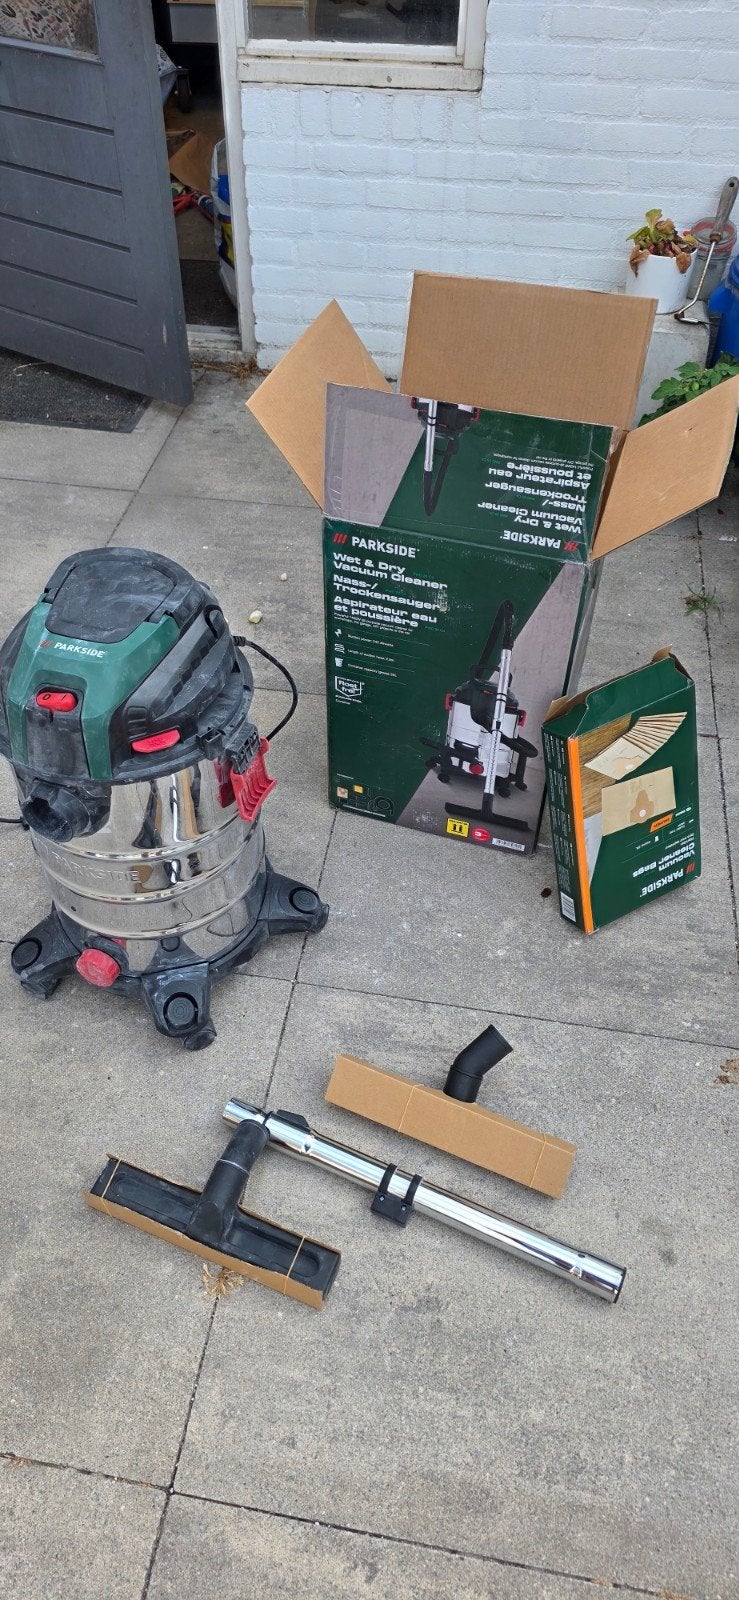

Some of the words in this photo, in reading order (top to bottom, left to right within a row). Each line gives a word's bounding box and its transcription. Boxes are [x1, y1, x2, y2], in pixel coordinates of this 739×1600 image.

[489, 467, 512, 478] eau
[507, 462, 574, 478] poussière
[516, 472, 591, 490] Aspirateur
[485, 481, 587, 504] Trockensauger
[477, 501, 528, 515] Cleaner
[542, 499, 585, 512] Nass-/
[514, 516, 539, 526] Dry
[532, 510, 583, 526] Vacuum
[542, 521, 552, 529] &
[556, 522, 581, 534] Wet
[352, 536, 416, 558] PARKSIDE
[503, 530, 560, 549] PARKSIDE
[333, 552, 361, 565] Wet
[365, 559, 374, 568] &
[379, 562, 406, 574] Dry
[333, 560, 388, 579] Vacuum
[391, 574, 448, 590] Cleaner
[333, 574, 378, 589] Nass-/
[333, 583, 440, 610] Trockensauger
[334, 596, 408, 616] Aspirateur
[412, 612, 437, 623] eau
[334, 604, 348, 613] et
[352, 608, 418, 627] poussière
[54, 642, 105, 658] PARKSIDE
[658, 842, 694, 864] Cleaner
[659, 850, 695, 871] Vacuum
[633, 862, 656, 877] Bags
[641, 868, 684, 895] PARKSIDE
